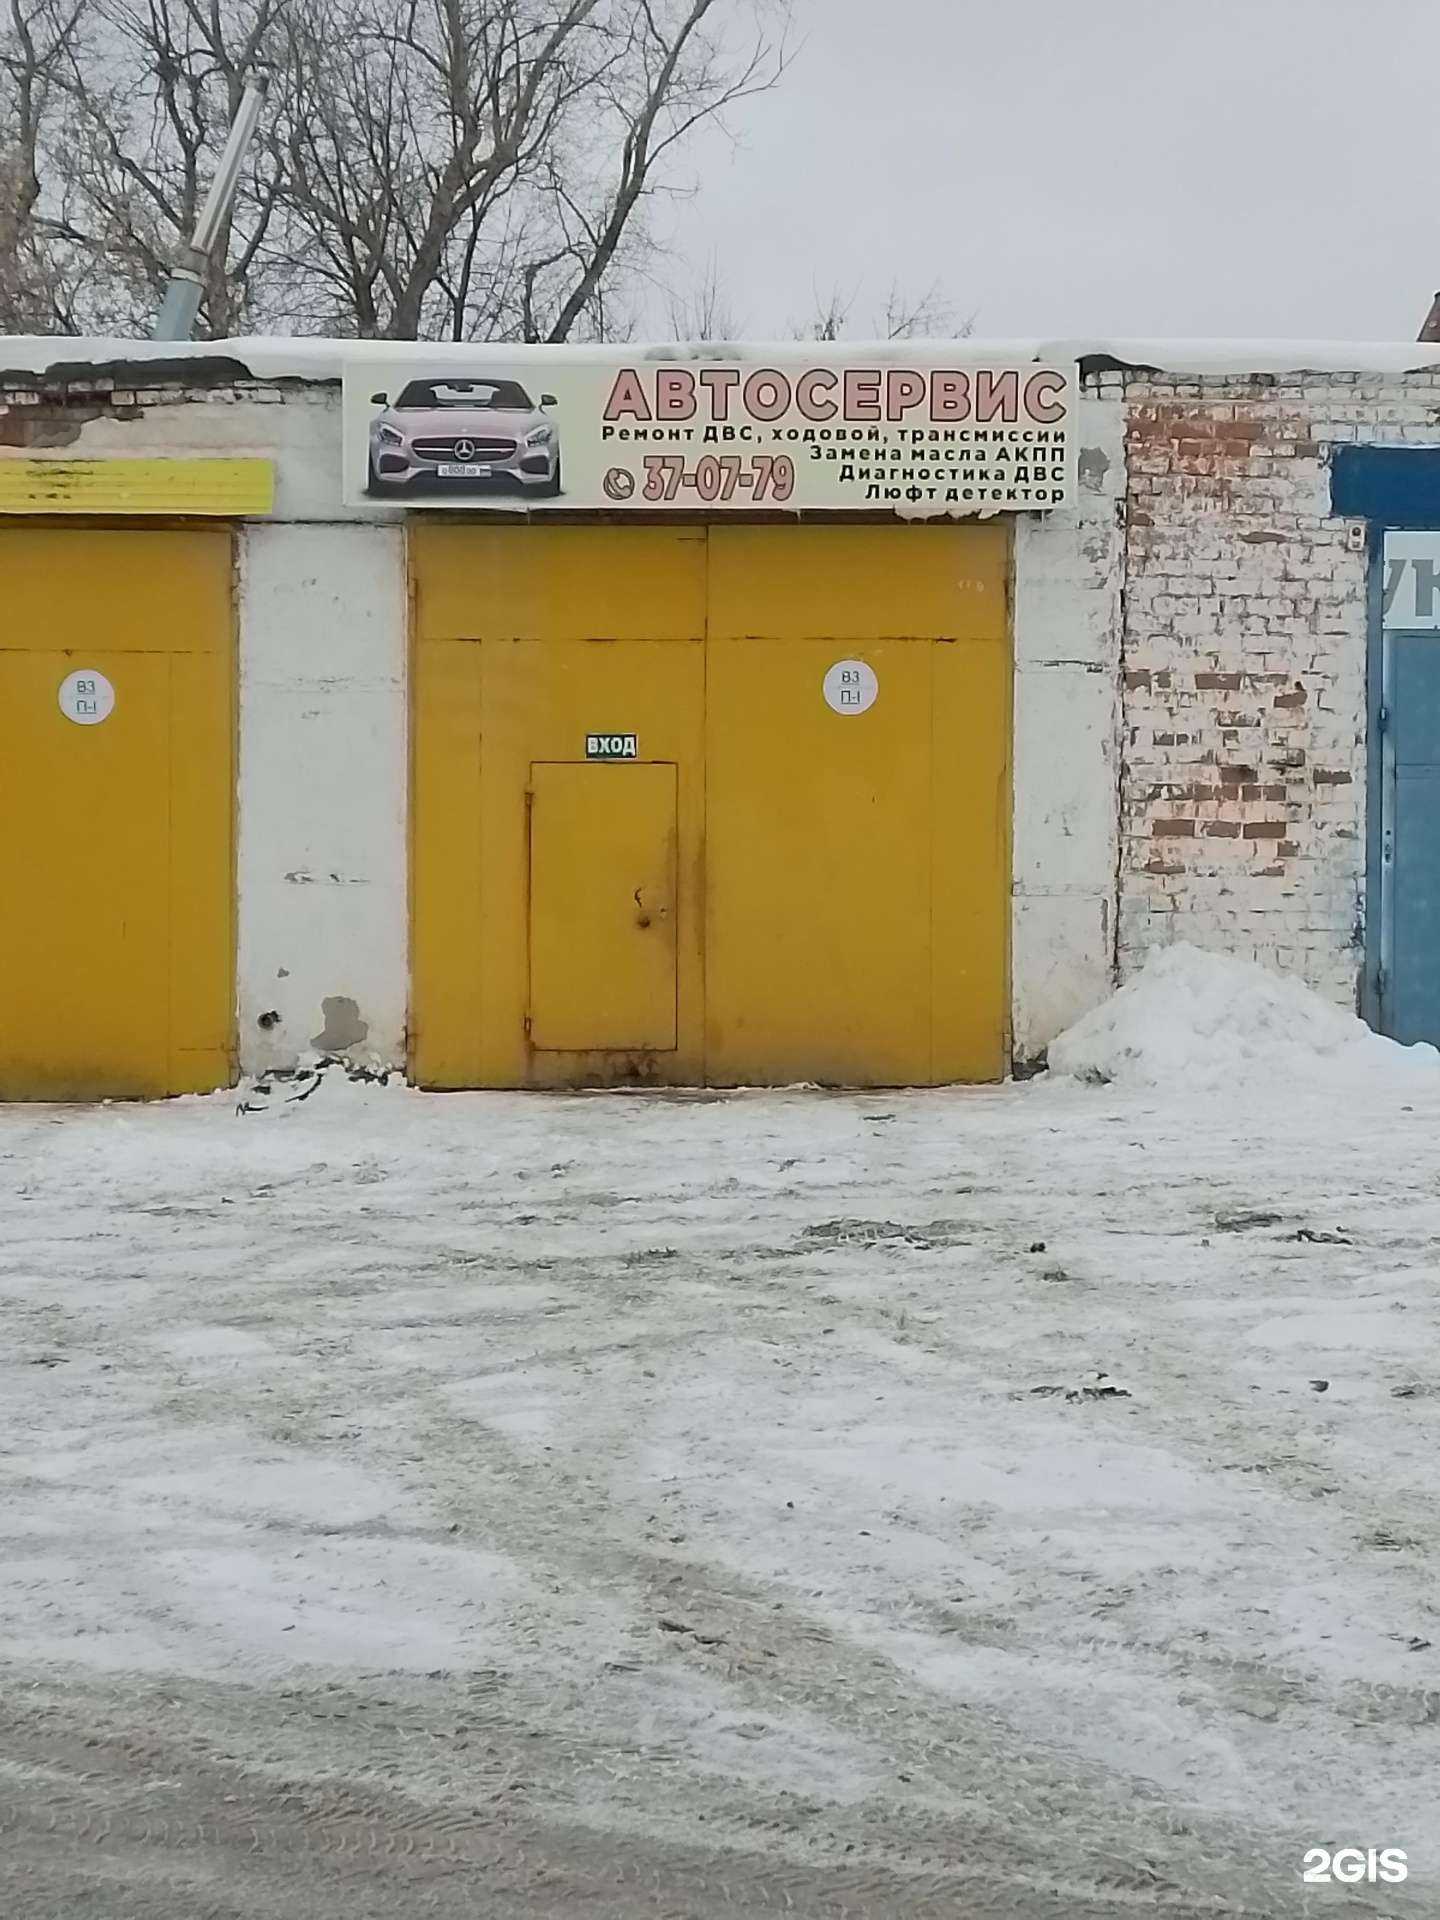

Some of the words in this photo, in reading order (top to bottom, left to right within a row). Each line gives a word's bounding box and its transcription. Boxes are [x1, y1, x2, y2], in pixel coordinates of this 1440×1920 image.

[602, 368, 1068, 424] АВТОСЕРВИС
[602, 426, 695, 441] Ремонт
[703, 426, 763, 443] ДВС,
[771, 426, 889, 443] ходовой,
[898, 429, 1066, 443] трансмиссии
[810, 445, 902, 461] Замена
[911, 447, 987, 462] масла
[995, 447, 1066, 463] АКПП
[642, 455, 796, 501] 37-07-79
[839, 465, 1007, 482] Диагностика
[1014, 466, 1066, 484] ДВС
[865, 485, 938, 502] Люфт
[945, 486, 1066, 504] детектор
[587, 736, 636, 756] ВХОД
